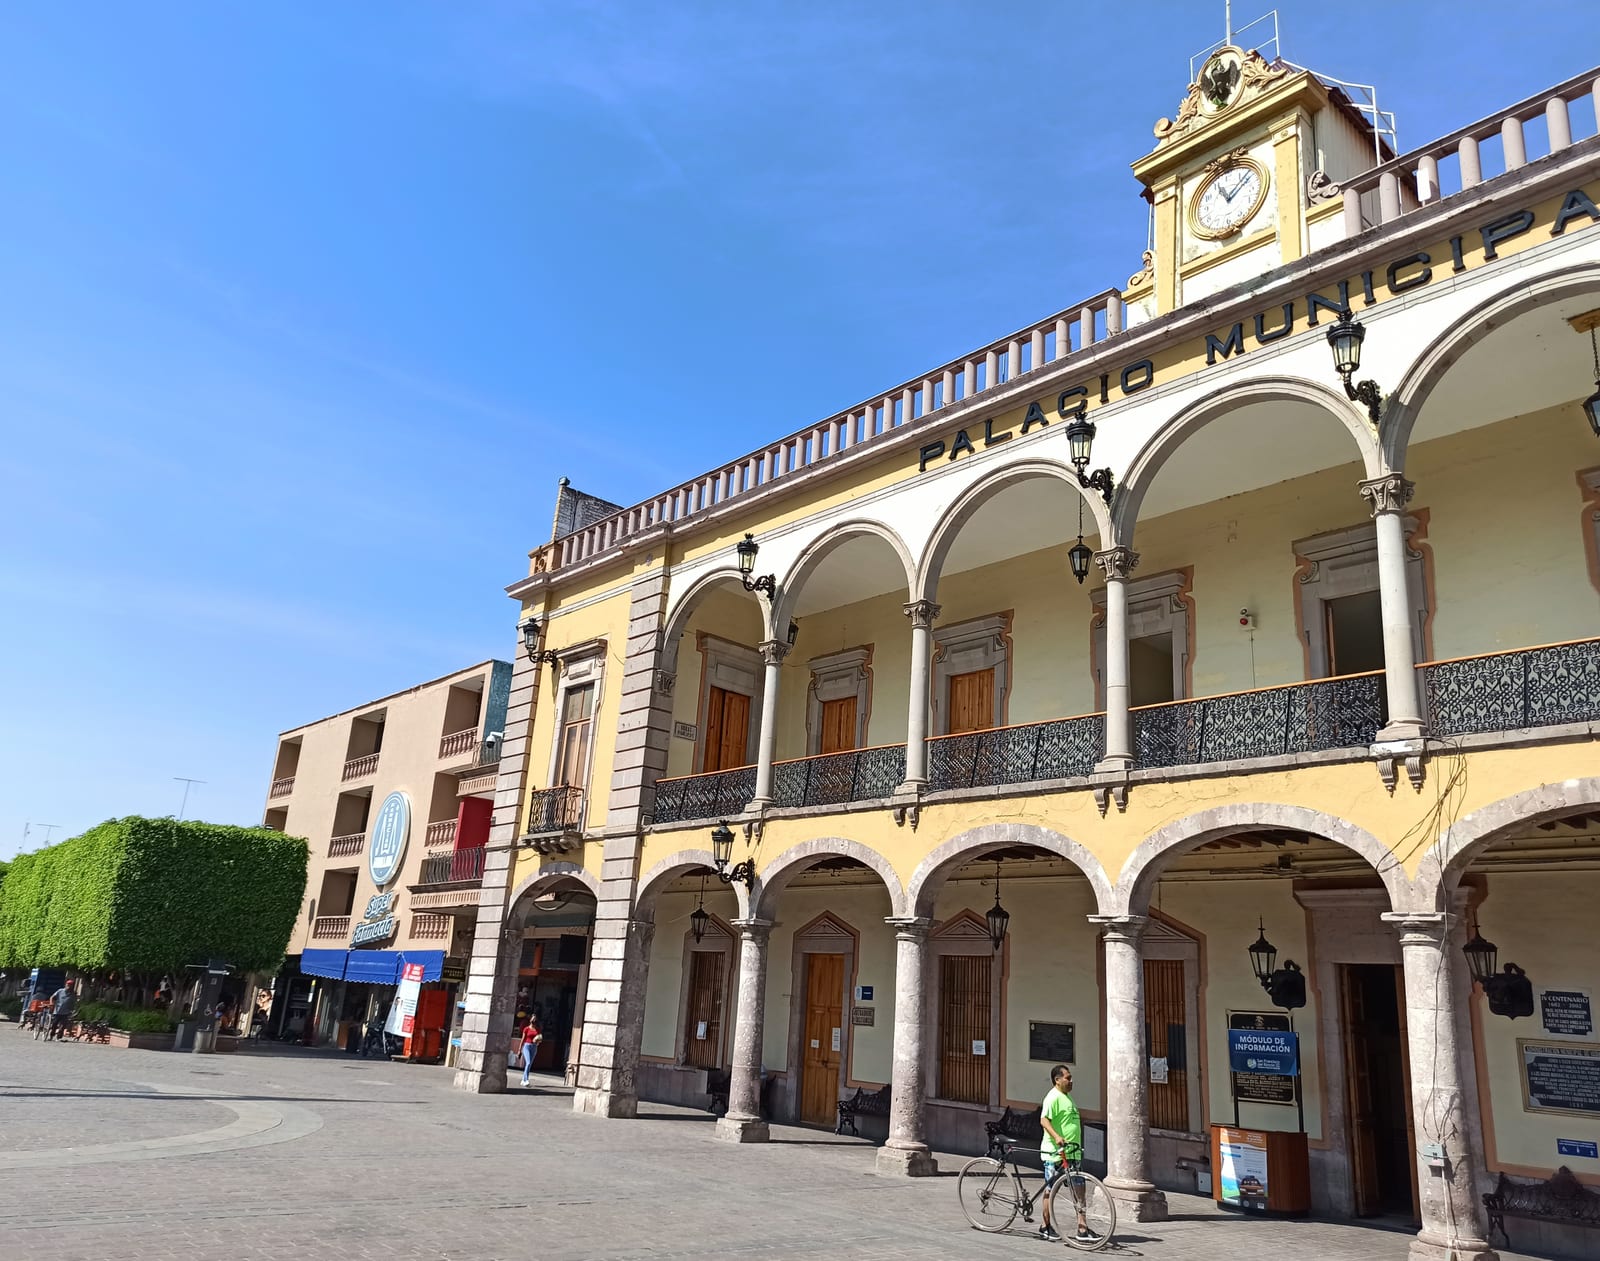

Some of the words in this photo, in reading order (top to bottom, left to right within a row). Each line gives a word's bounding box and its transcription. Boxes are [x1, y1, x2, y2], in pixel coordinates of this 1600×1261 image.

[919, 359, 1153, 472] PALACIO
[365, 891, 393, 918] Super
[1235, 1043, 1290, 1053] INFORMACIÓN
[1239, 1034, 1273, 1045] MÓDULO
[1275, 1037, 1285, 1045] DE
